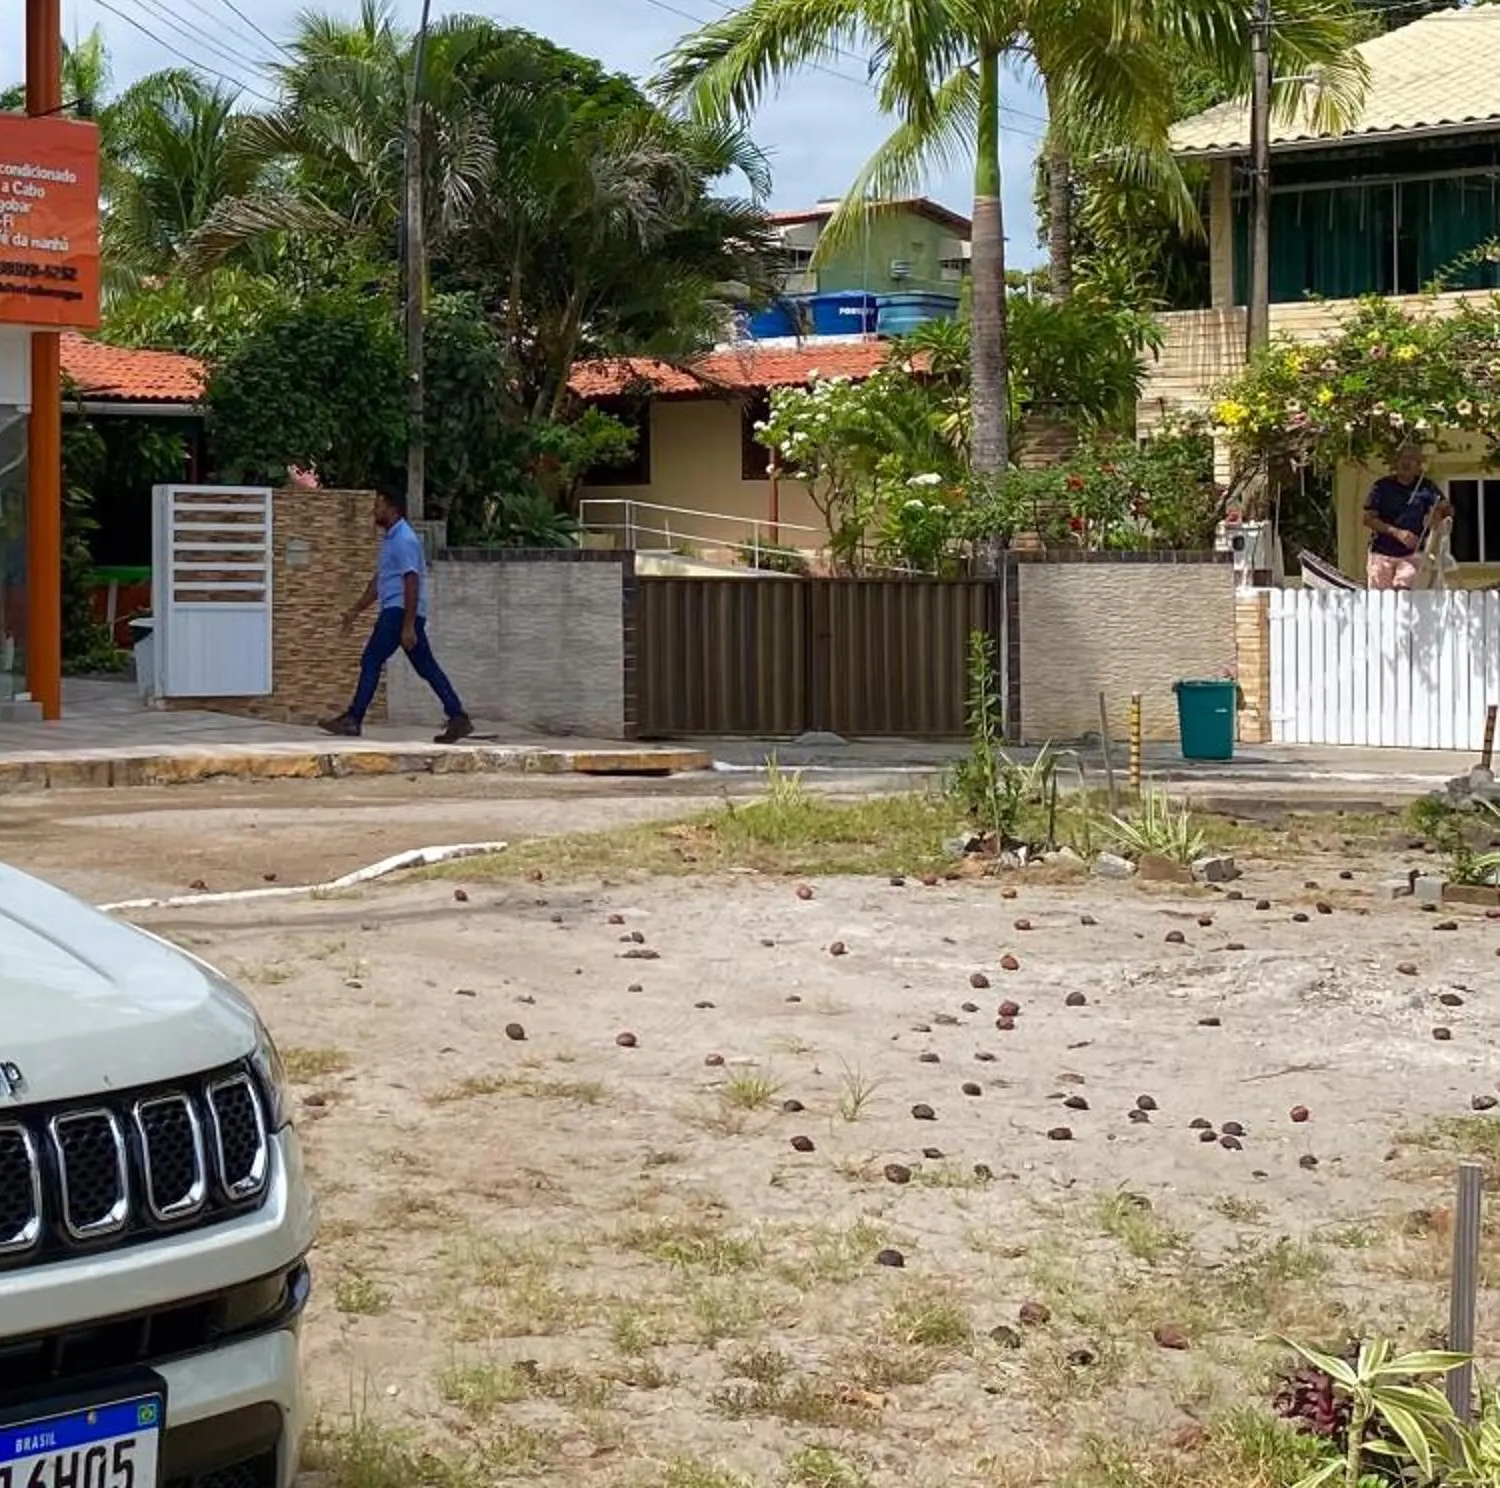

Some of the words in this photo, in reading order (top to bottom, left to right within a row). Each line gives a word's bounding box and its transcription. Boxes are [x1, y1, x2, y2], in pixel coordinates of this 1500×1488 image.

[1, 181, 10, 192] a
[12, 181, 45, 198] Cabo
[11, 232, 29, 247] da
[15, 1432, 56, 1453] BRASIL
